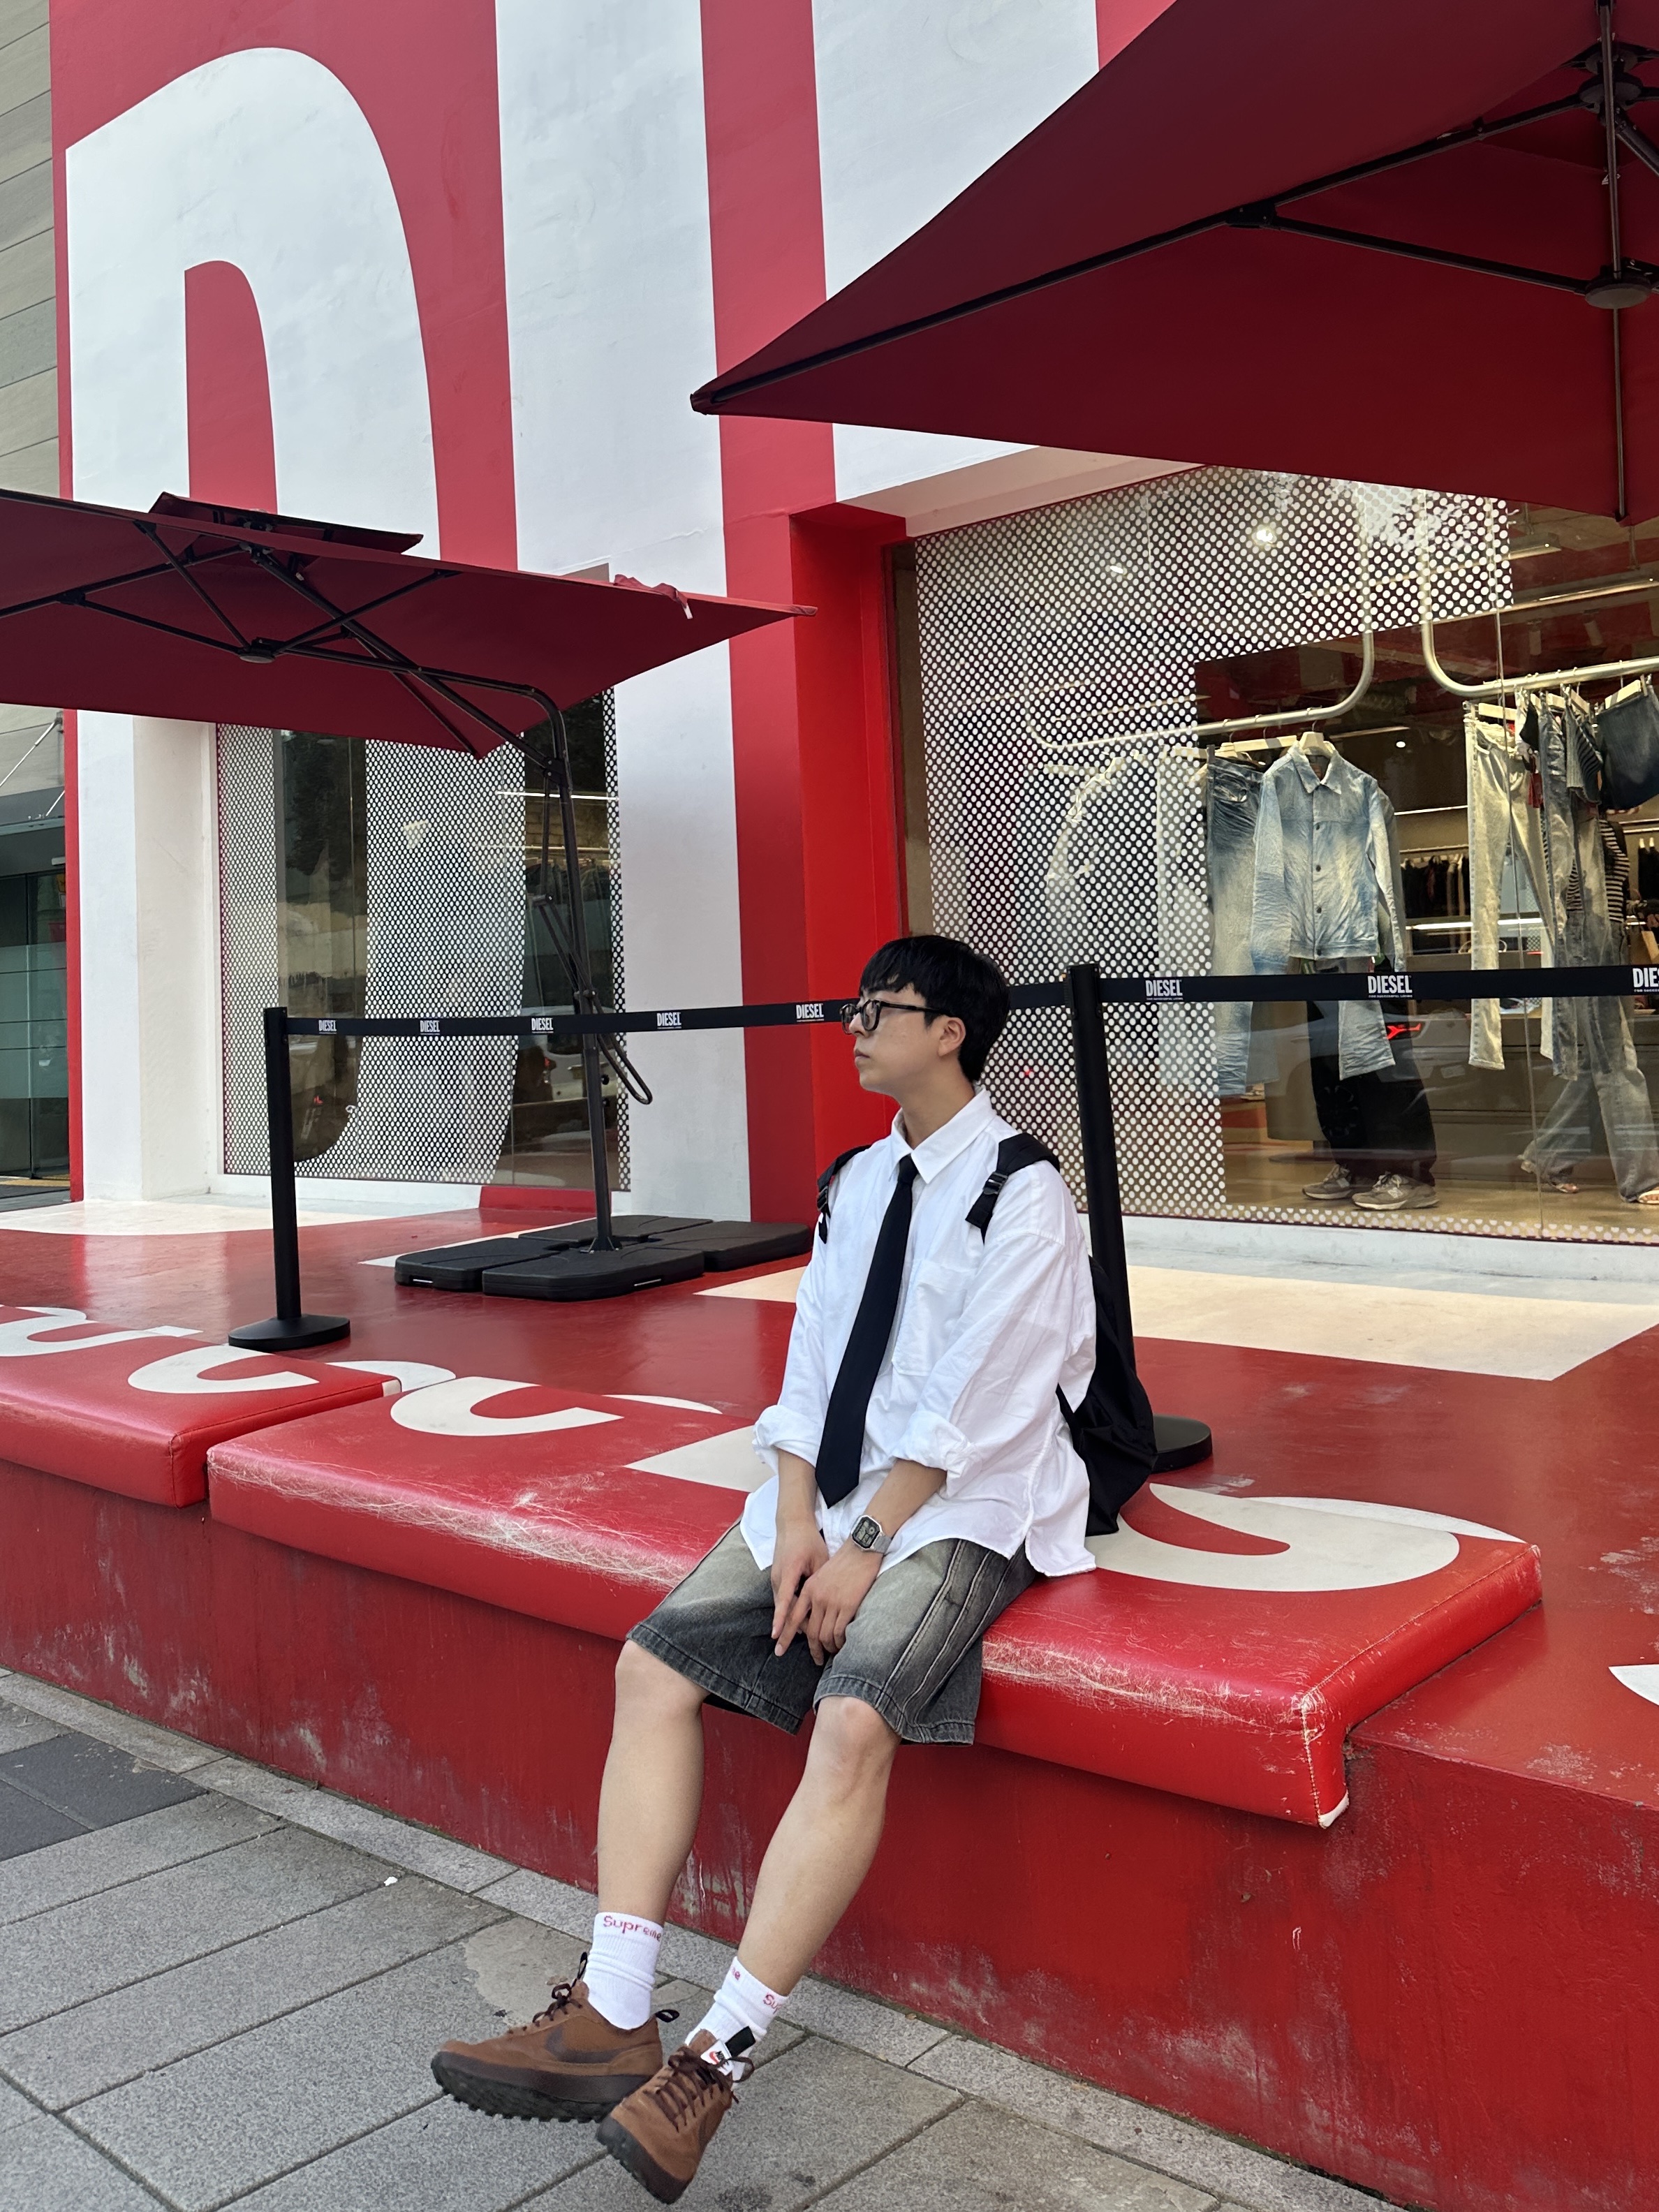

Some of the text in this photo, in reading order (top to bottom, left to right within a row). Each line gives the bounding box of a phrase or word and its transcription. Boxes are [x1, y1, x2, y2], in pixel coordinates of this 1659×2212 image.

[1367, 975, 1413, 994] DIESEL
[1632, 967, 1659, 987] DIE
[1145, 979, 1183, 996] DIESEL
[656, 1012, 681, 1026] DIESEL
[796, 1003, 824, 1019] DIESEL
[318, 1019, 337, 1031] DIESEL
[420, 1020, 440, 1032] DIESEL
[531, 1017, 553, 1031] DIESEL
[603, 1915, 662, 1941] Supreme
